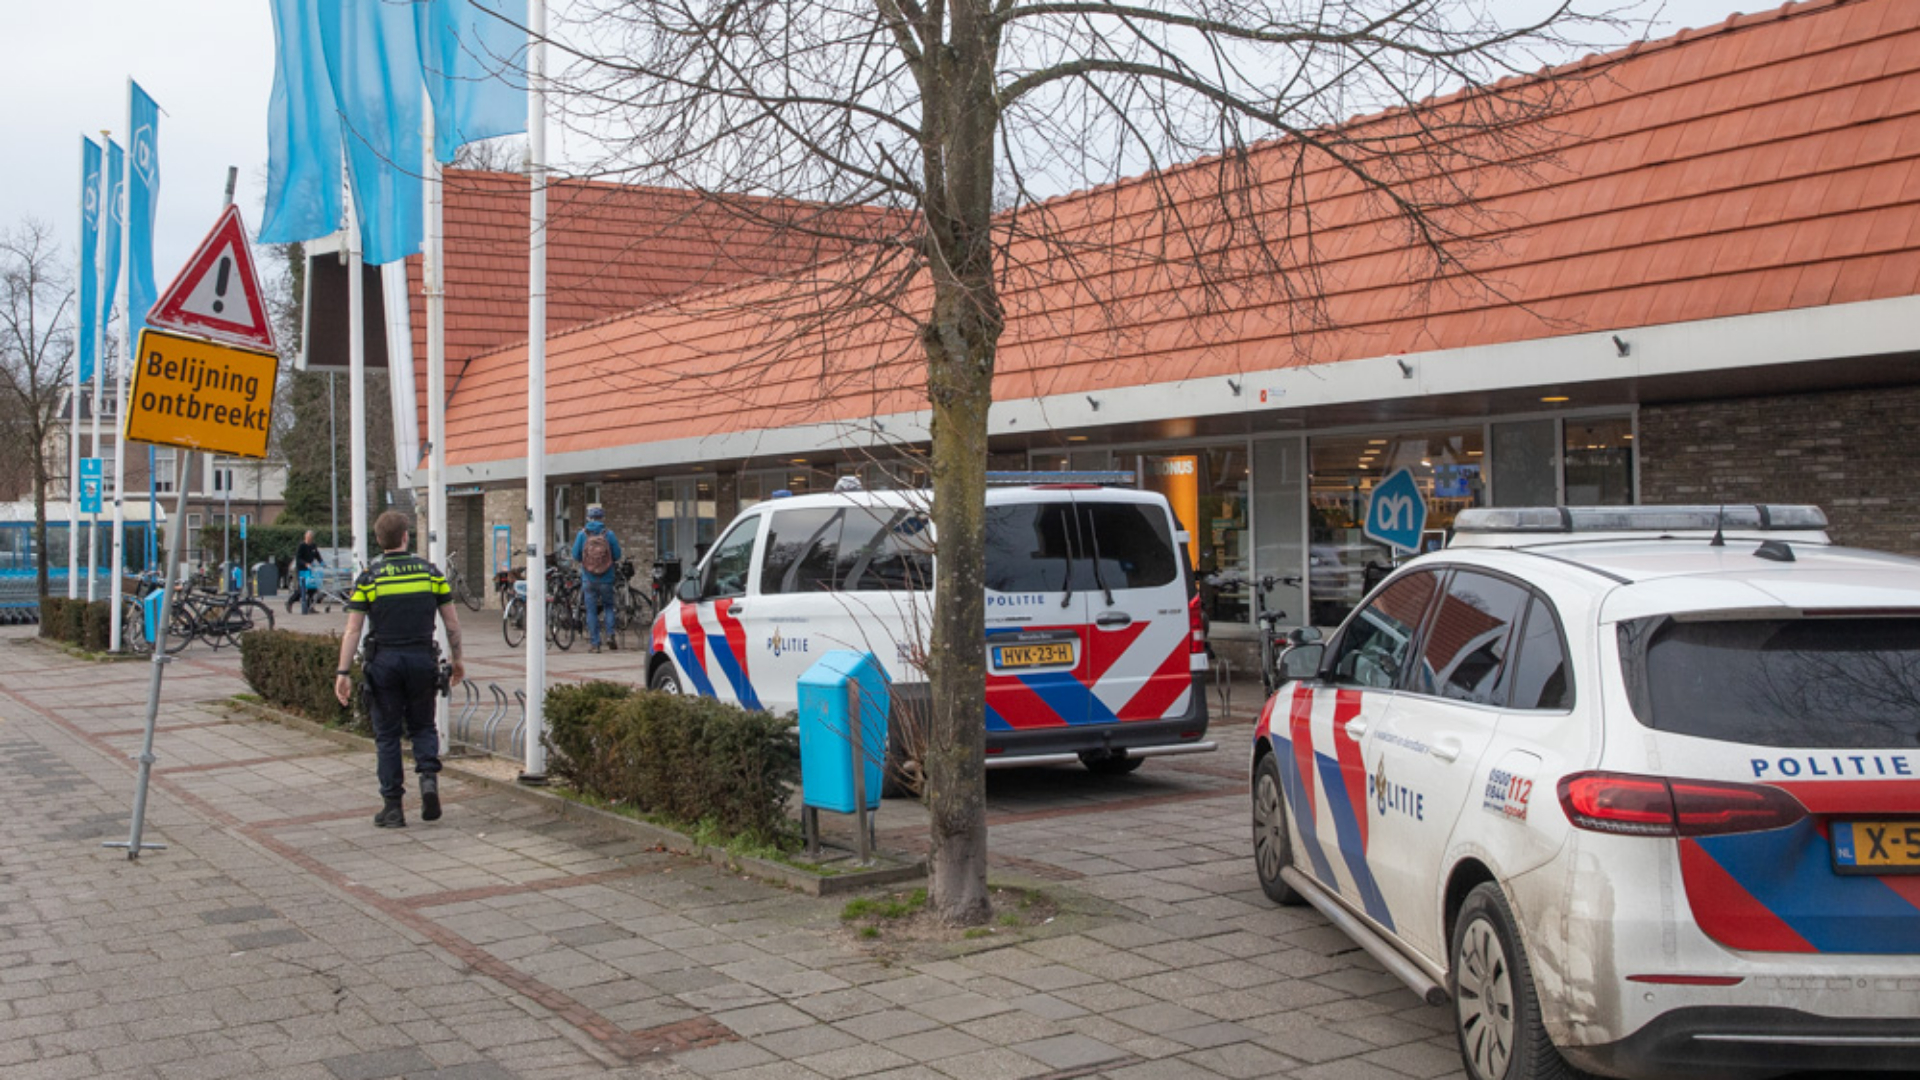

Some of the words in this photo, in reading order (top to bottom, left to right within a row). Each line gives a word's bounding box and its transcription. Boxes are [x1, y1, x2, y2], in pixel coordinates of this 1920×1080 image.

[147, 351, 259, 402] Belijning
[141, 391, 267, 431] ontbreekt
[986, 594, 1045, 607] POLITIE
[1004, 645, 1068, 664] HVK-23-H
[1750, 756, 1912, 778] POLITIE
[1508, 775, 1533, 805] 112
[1837, 848, 1853, 859] NL
